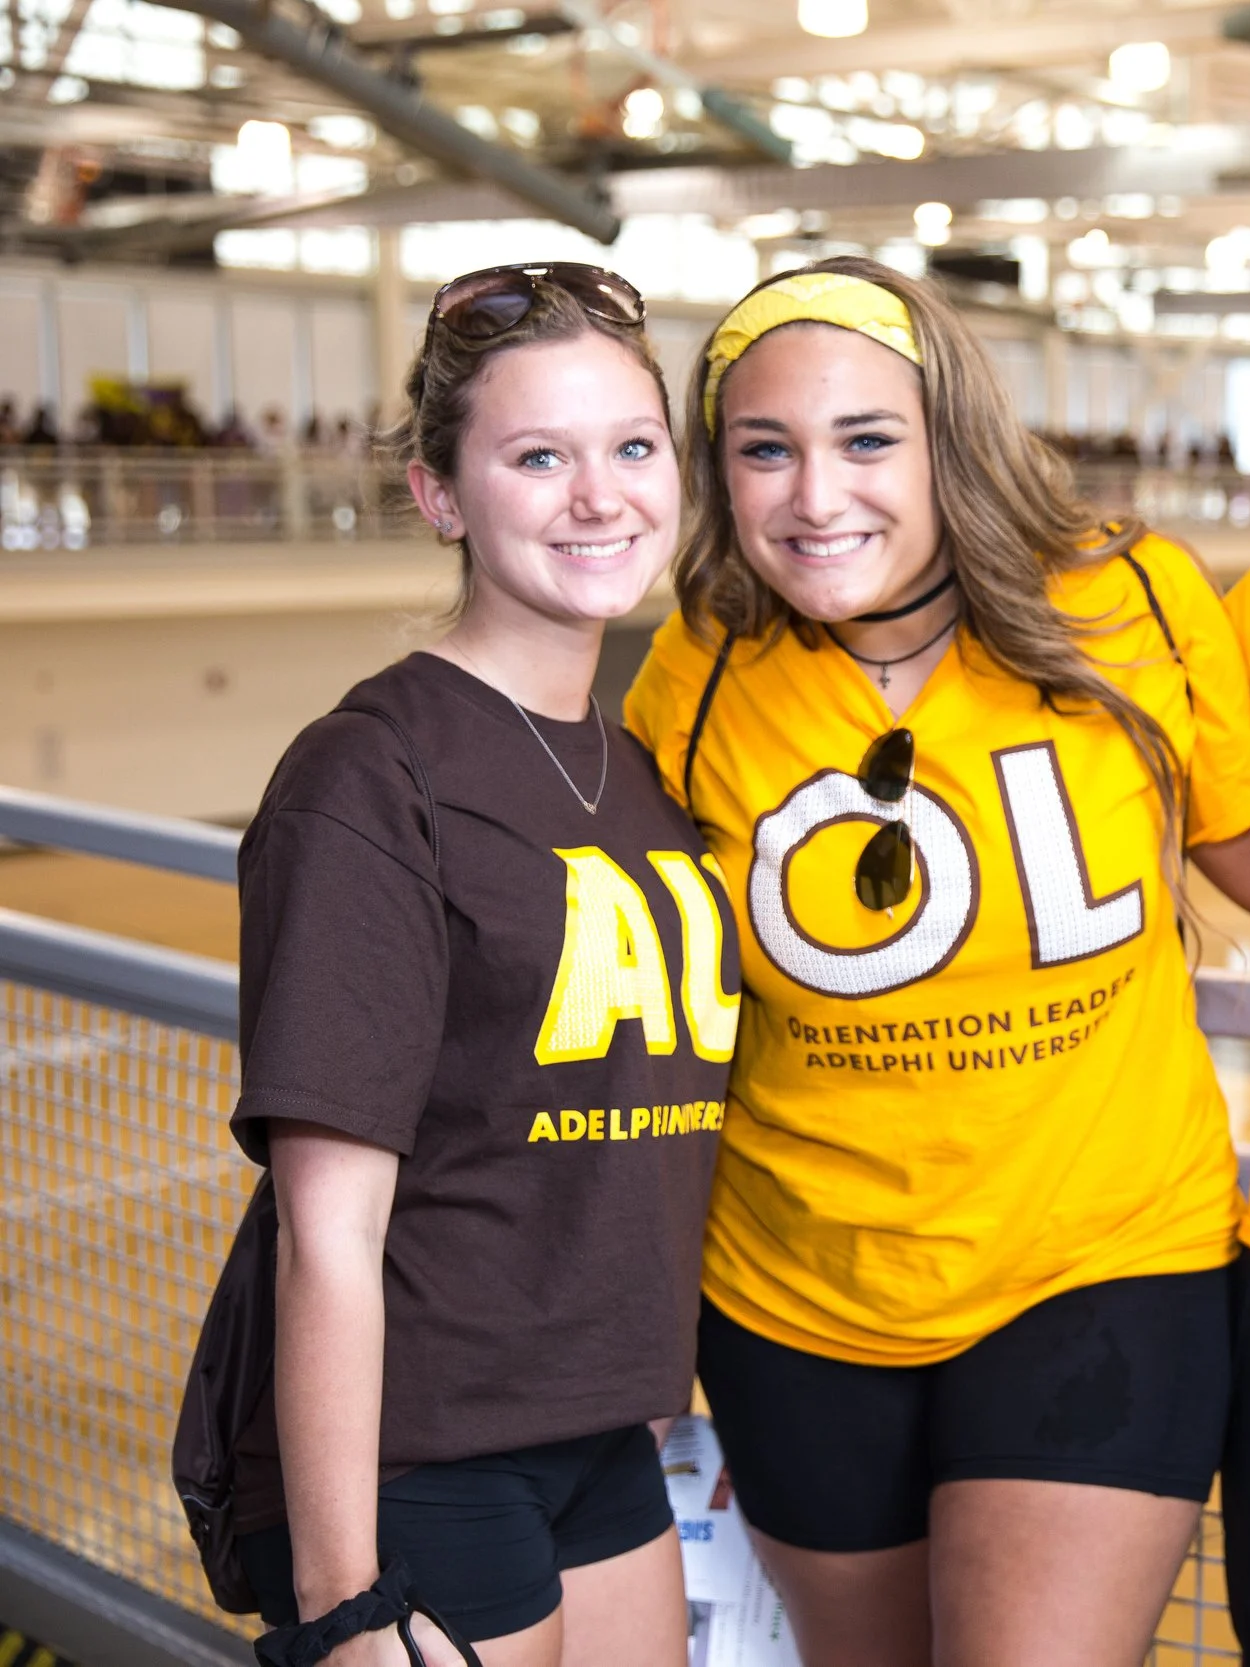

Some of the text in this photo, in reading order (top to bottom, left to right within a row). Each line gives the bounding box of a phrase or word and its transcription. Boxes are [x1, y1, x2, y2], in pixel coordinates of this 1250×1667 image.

[747, 739, 1144, 1000] OL
[534, 846, 742, 1064] AU
[787, 1010, 1012, 1045] ORIENTATION
[806, 1050, 935, 1073] ADELPHI
